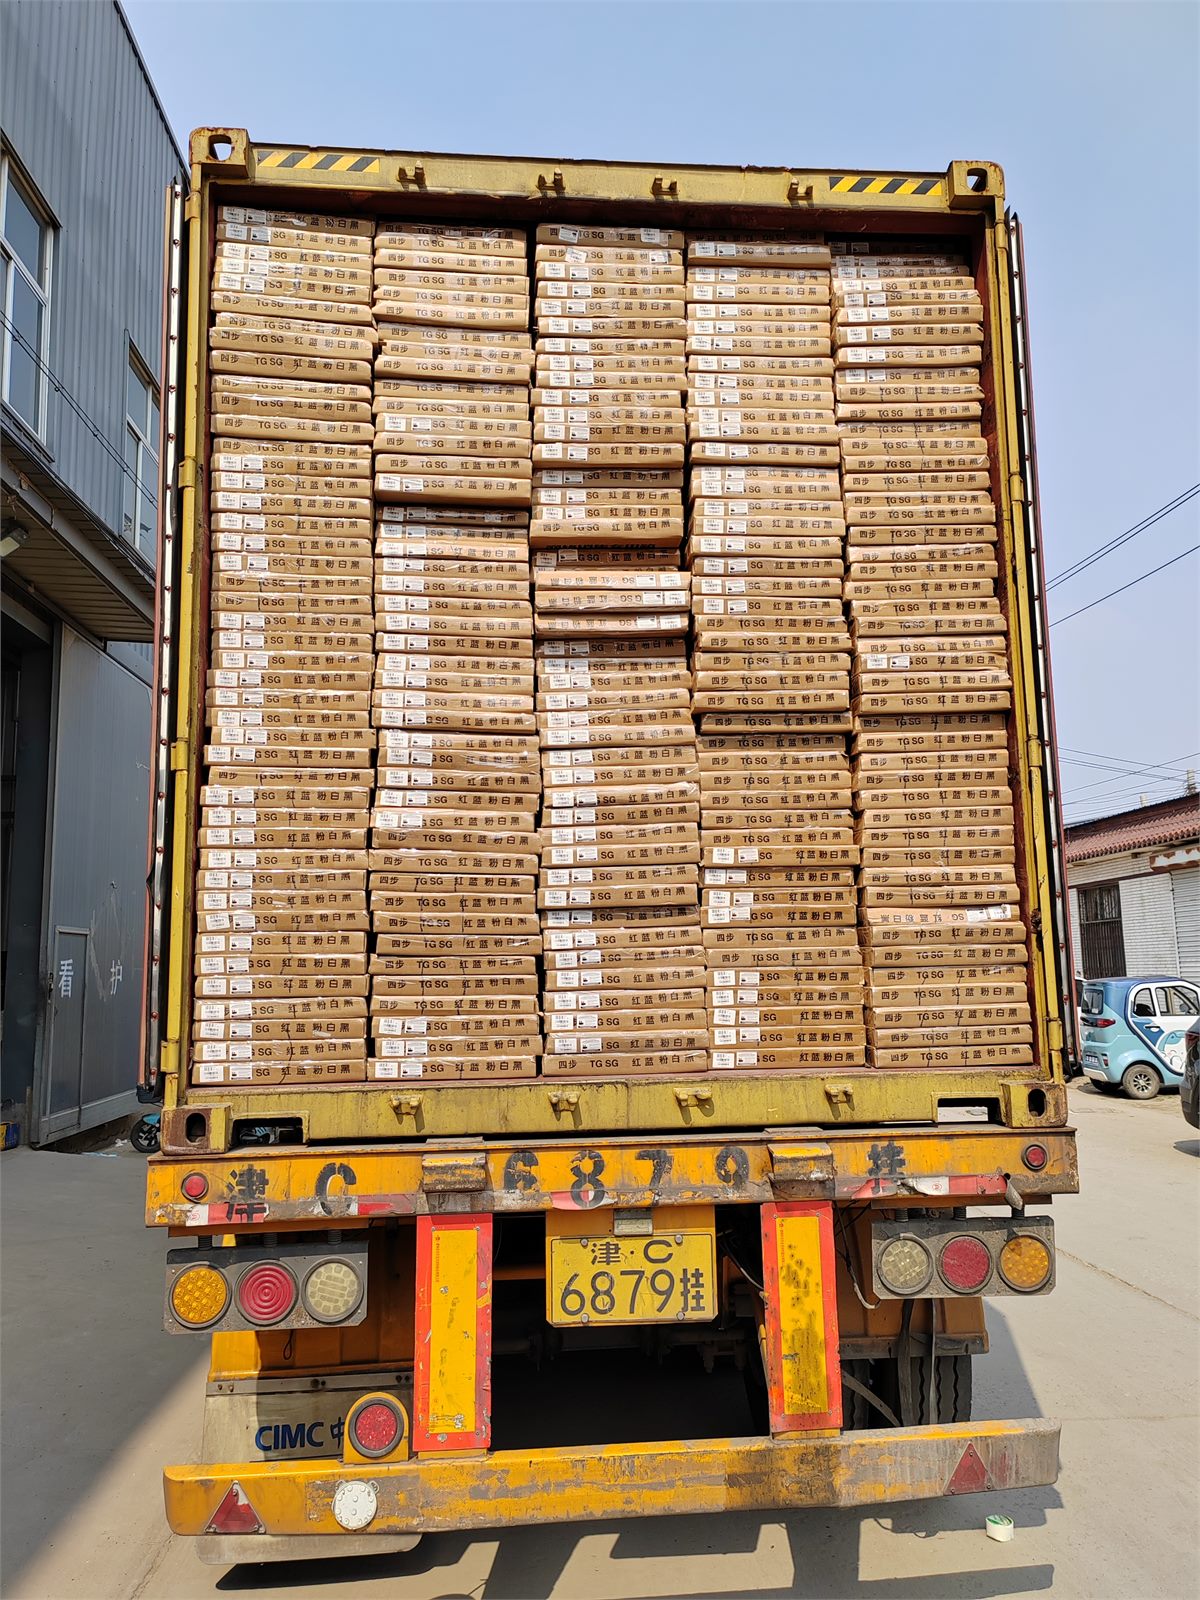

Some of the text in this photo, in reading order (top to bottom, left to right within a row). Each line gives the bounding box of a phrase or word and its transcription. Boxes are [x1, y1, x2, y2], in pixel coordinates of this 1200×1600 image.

[386, 307, 404, 315] 四步
[221, 354, 239, 363] 四步
[850, 410, 866, 418] 四步
[224, 419, 243, 427] 四步
[387, 438, 404, 446] 四步
[390, 459, 408, 468] 四步
[707, 619, 724, 627] 四步
[711, 638, 728, 646] 四步
[708, 697, 725, 705] 四步
[713, 796, 728, 804] 四步
[871, 794, 888, 802] 四步
[873, 814, 890, 822] 四步
[388, 833, 407, 841] 四步
[714, 835, 731, 843] 四步
[384, 857, 402, 865] 四步
[873, 853, 890, 861] 四步
[380, 876, 399, 884] 四步
[883, 931, 900, 939] 四步
[722, 954, 740, 962] 四步
[380, 1001, 398, 1009] 四步
[885, 1014, 902, 1022] 四步
[559, 1060, 577, 1069] 四步
[255, 1421, 324, 1451] CIMC
